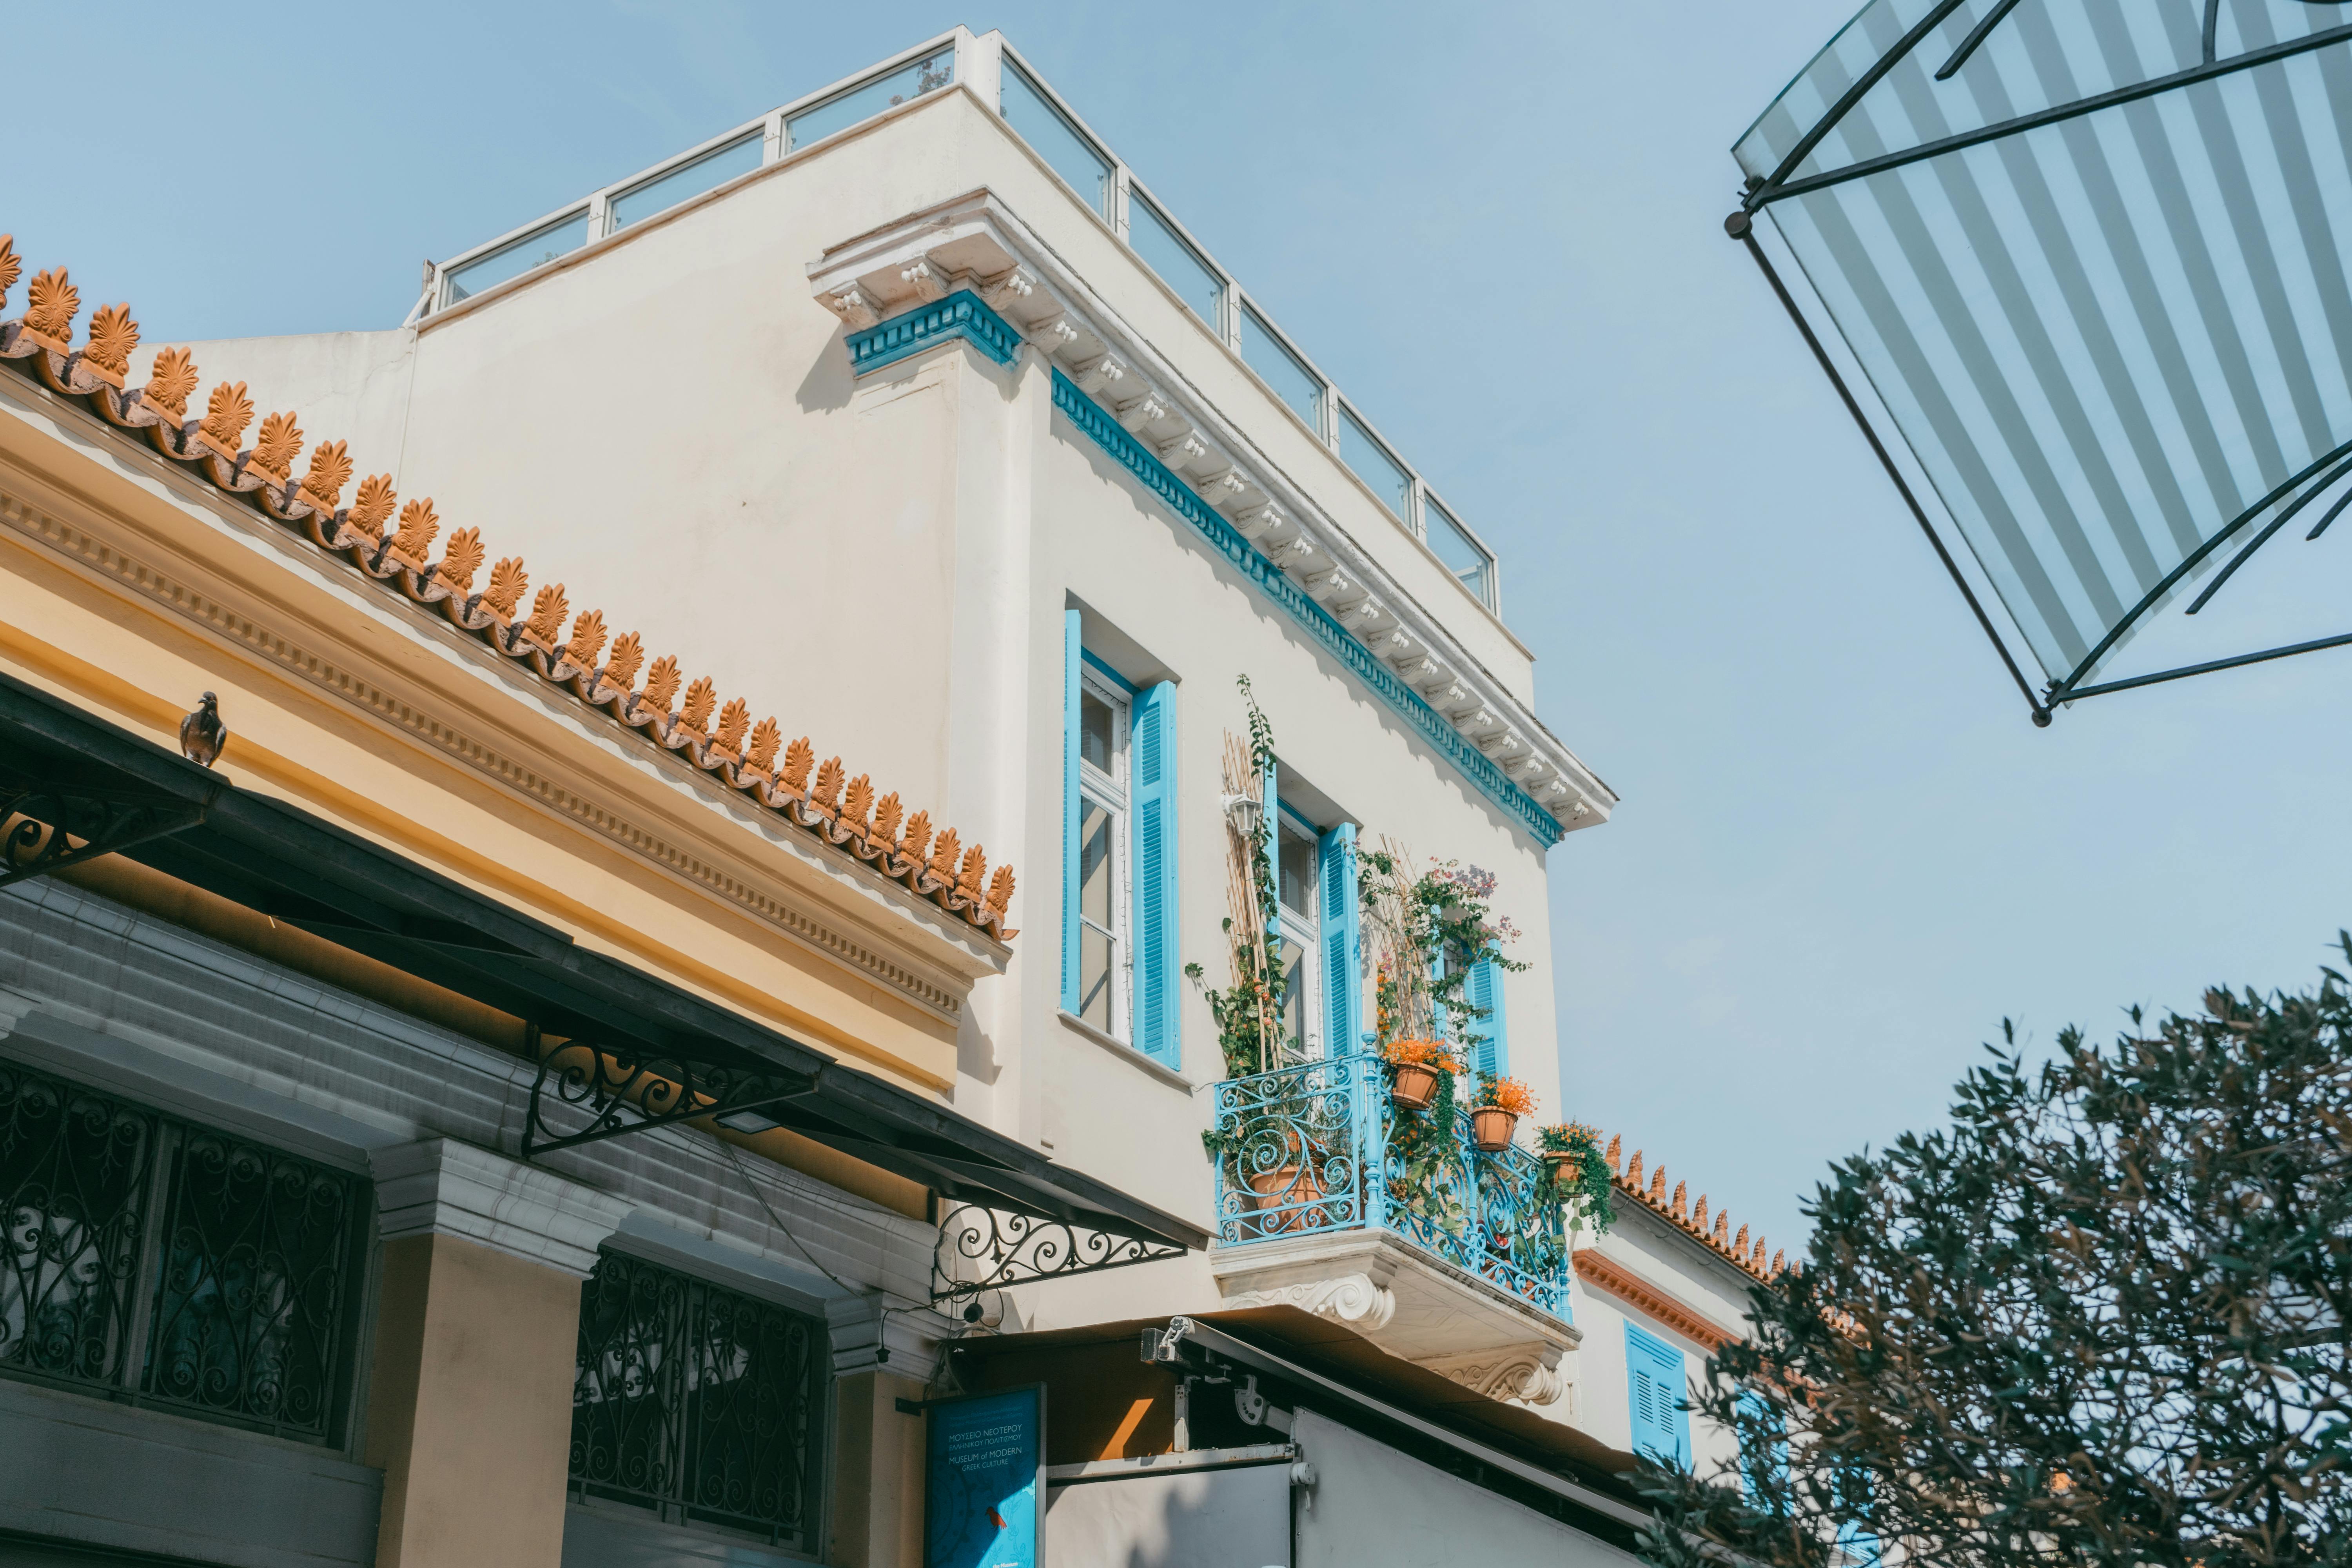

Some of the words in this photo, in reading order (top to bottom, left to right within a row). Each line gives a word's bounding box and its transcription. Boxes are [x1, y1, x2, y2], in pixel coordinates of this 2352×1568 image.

[949, 1431, 981, 1442] ΜΟΥΣΕΙΟ
[983, 1423, 1022, 1437] ΝΕΟΤΕΡΟΥ
[949, 1440, 983, 1451] ΕΛΛΗΝΙΚΟΥ
[985, 1434, 1022, 1445] ΠΟΛΙΤΙΣΜΟΥ
[949, 1453, 979, 1465] MUSEUM
[989, 1446, 1022, 1458] MODERN
[962, 1463, 980, 1471] GREEK
[982, 1458, 1009, 1468] CULTURE
